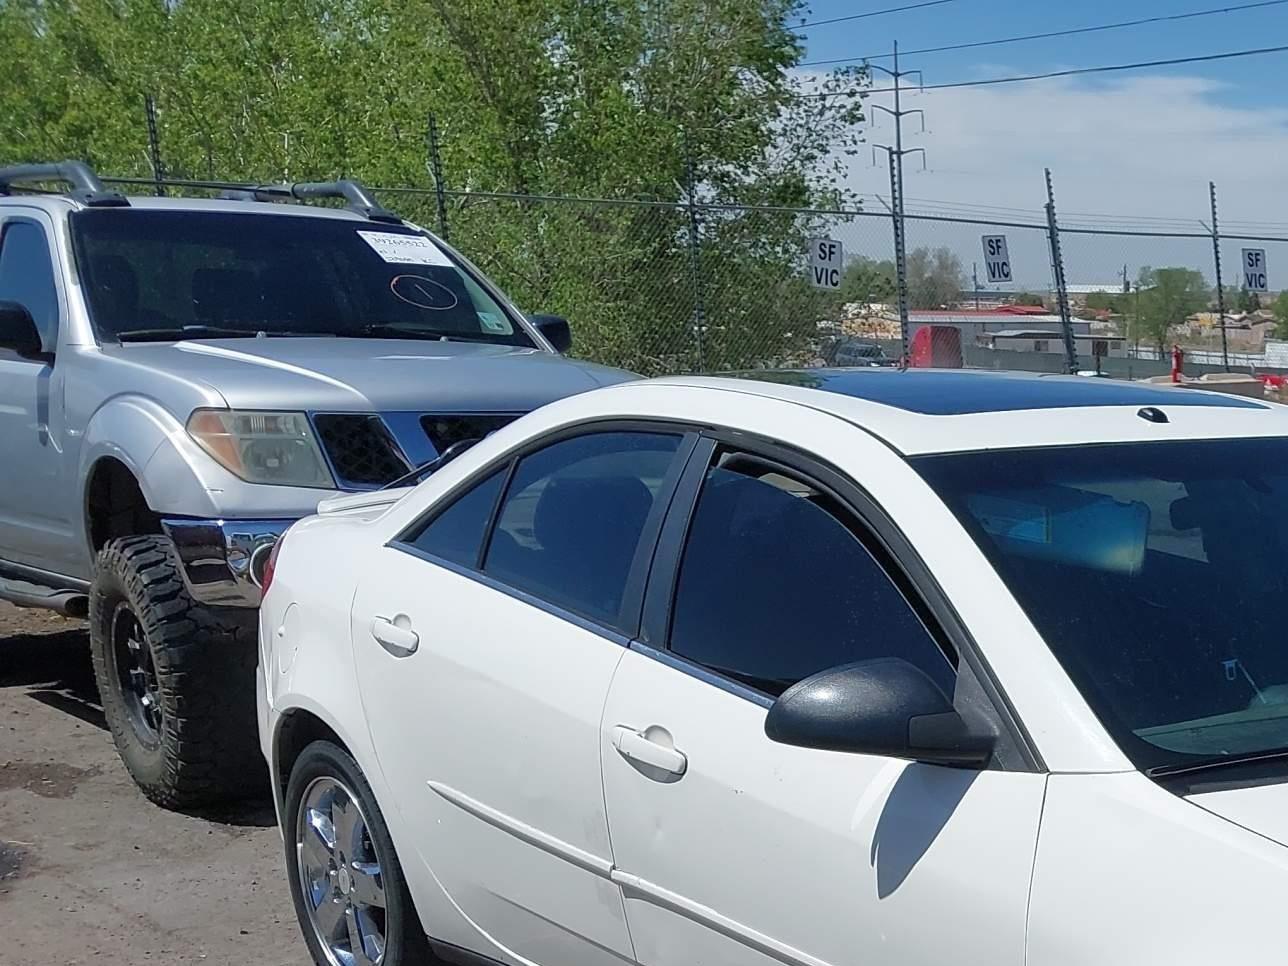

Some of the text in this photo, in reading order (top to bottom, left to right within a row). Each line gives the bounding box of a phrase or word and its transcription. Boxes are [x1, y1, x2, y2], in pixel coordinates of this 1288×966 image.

[818, 242, 837, 262] SF
[987, 238, 1002, 256] SF
[1247, 251, 1261, 268] SF
[814, 265, 840, 287] VIC
[987, 261, 1010, 279] VIC
[1245, 272, 1265, 289] VIC
